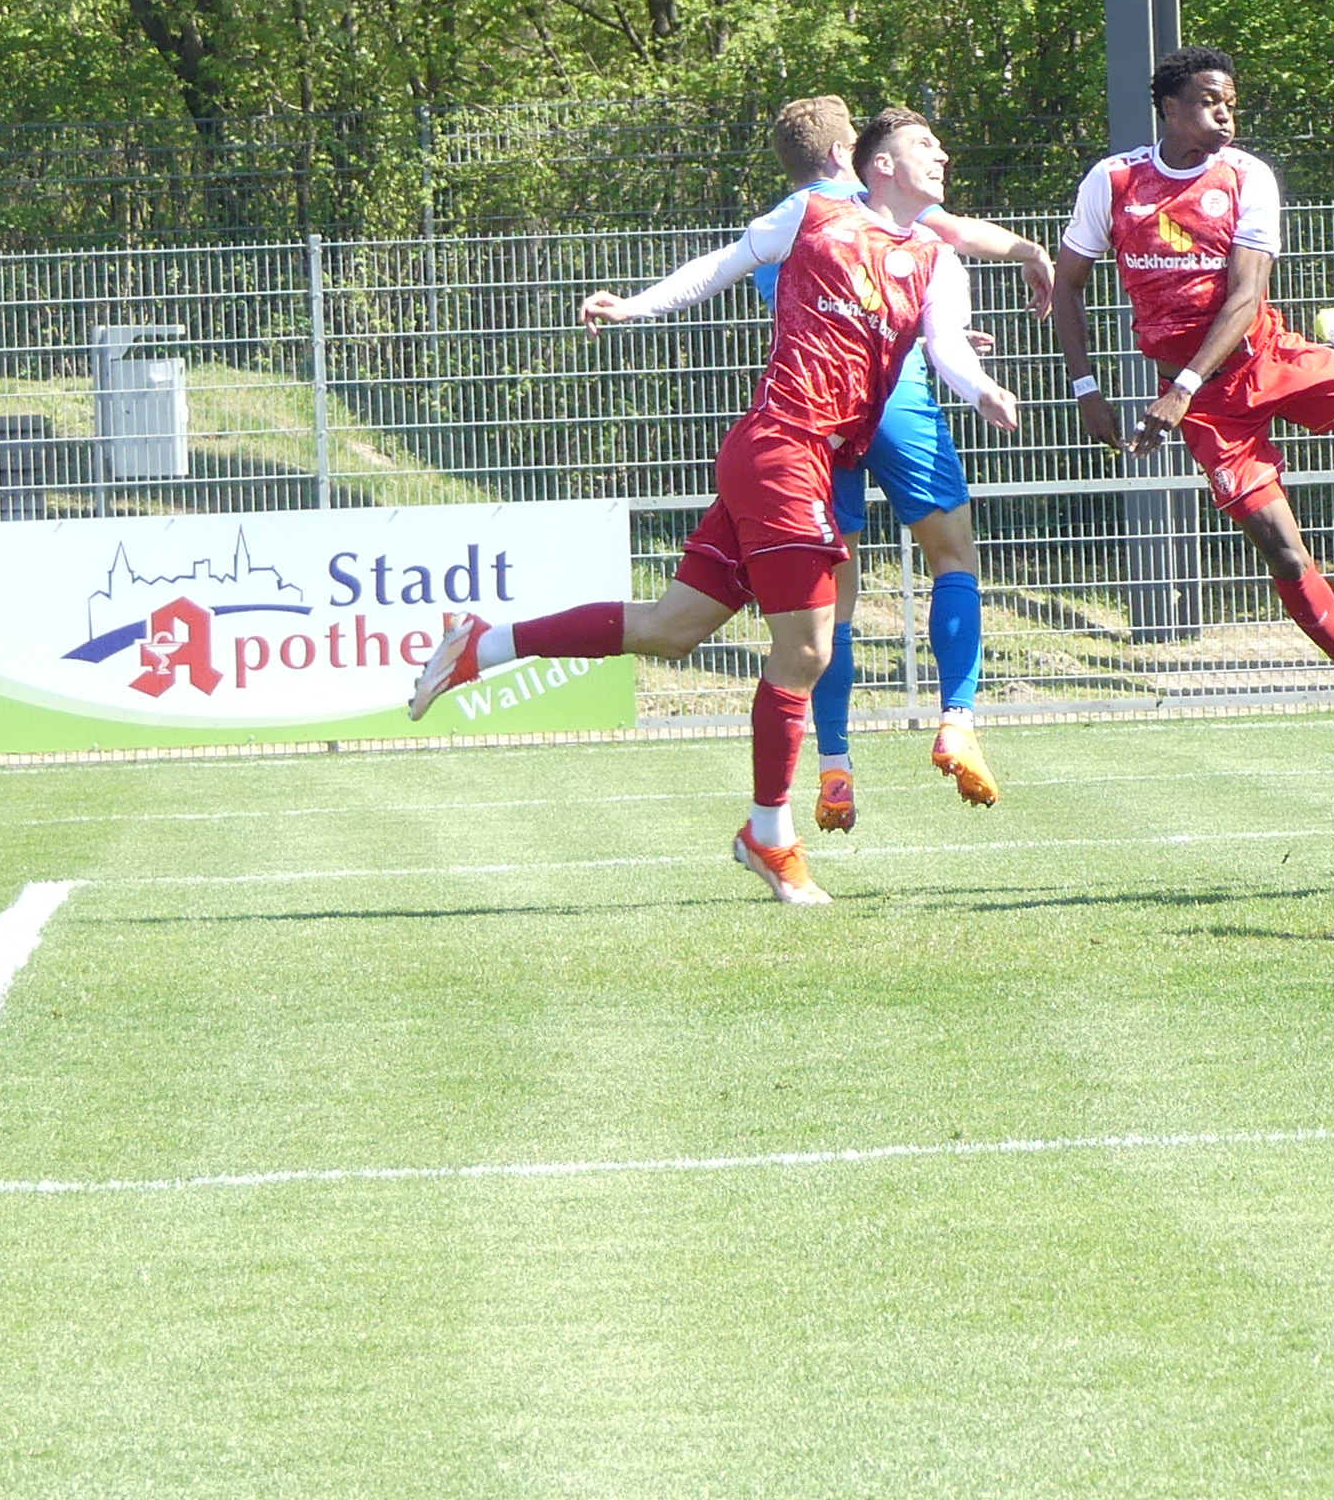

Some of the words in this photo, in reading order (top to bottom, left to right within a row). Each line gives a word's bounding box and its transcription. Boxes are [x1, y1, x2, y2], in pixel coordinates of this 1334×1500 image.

[1125, 253, 1199, 270] bickhardt
[329, 543, 515, 607] Stadt
[128, 596, 453, 697] Apothe
[456, 656, 605, 721] Walldo
